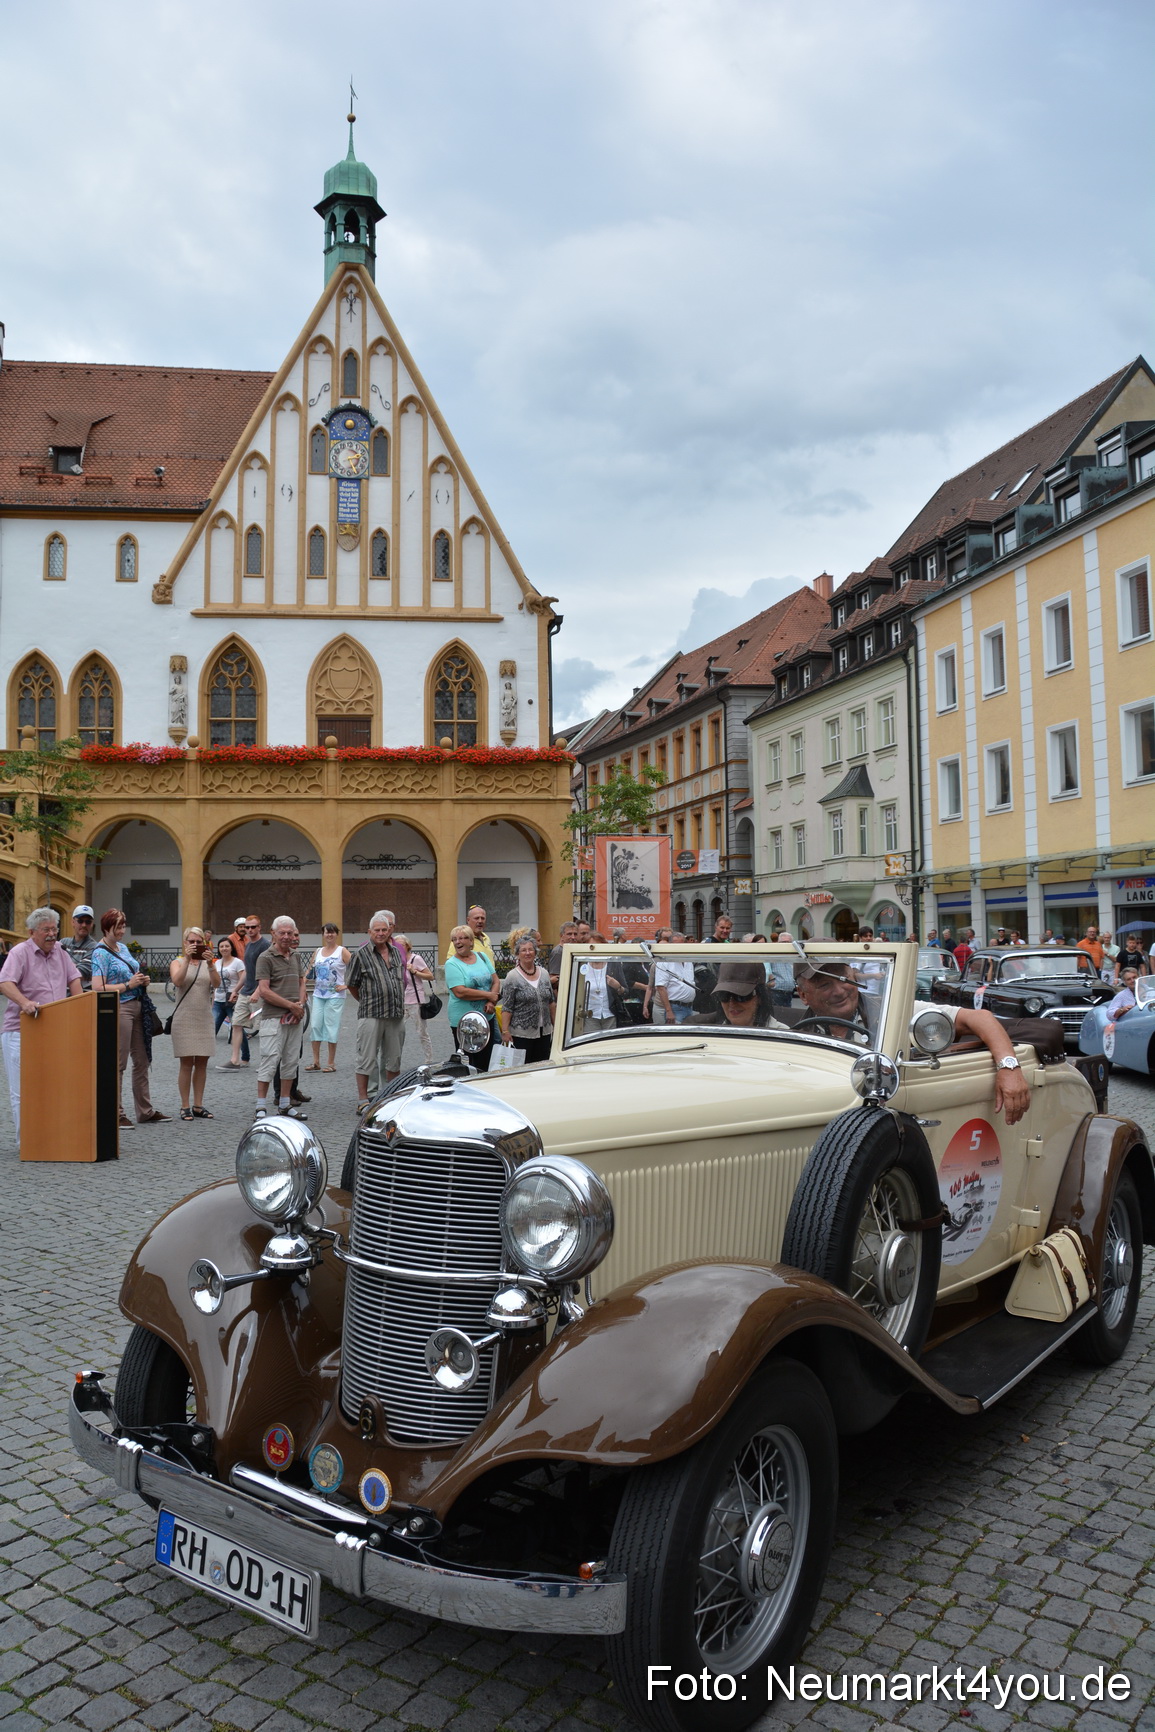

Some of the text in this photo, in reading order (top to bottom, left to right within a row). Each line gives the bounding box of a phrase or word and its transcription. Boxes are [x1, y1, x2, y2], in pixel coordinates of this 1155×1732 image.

[1126, 890, 1154, 902] LANG
[612, 915, 656, 924] PICASSO
[969, 1129, 983, 1151] 5
[360, 1407, 373, 1433] 6
[160, 1541, 168, 1555] D
[170, 1522, 309, 1626] RH OD 1H
